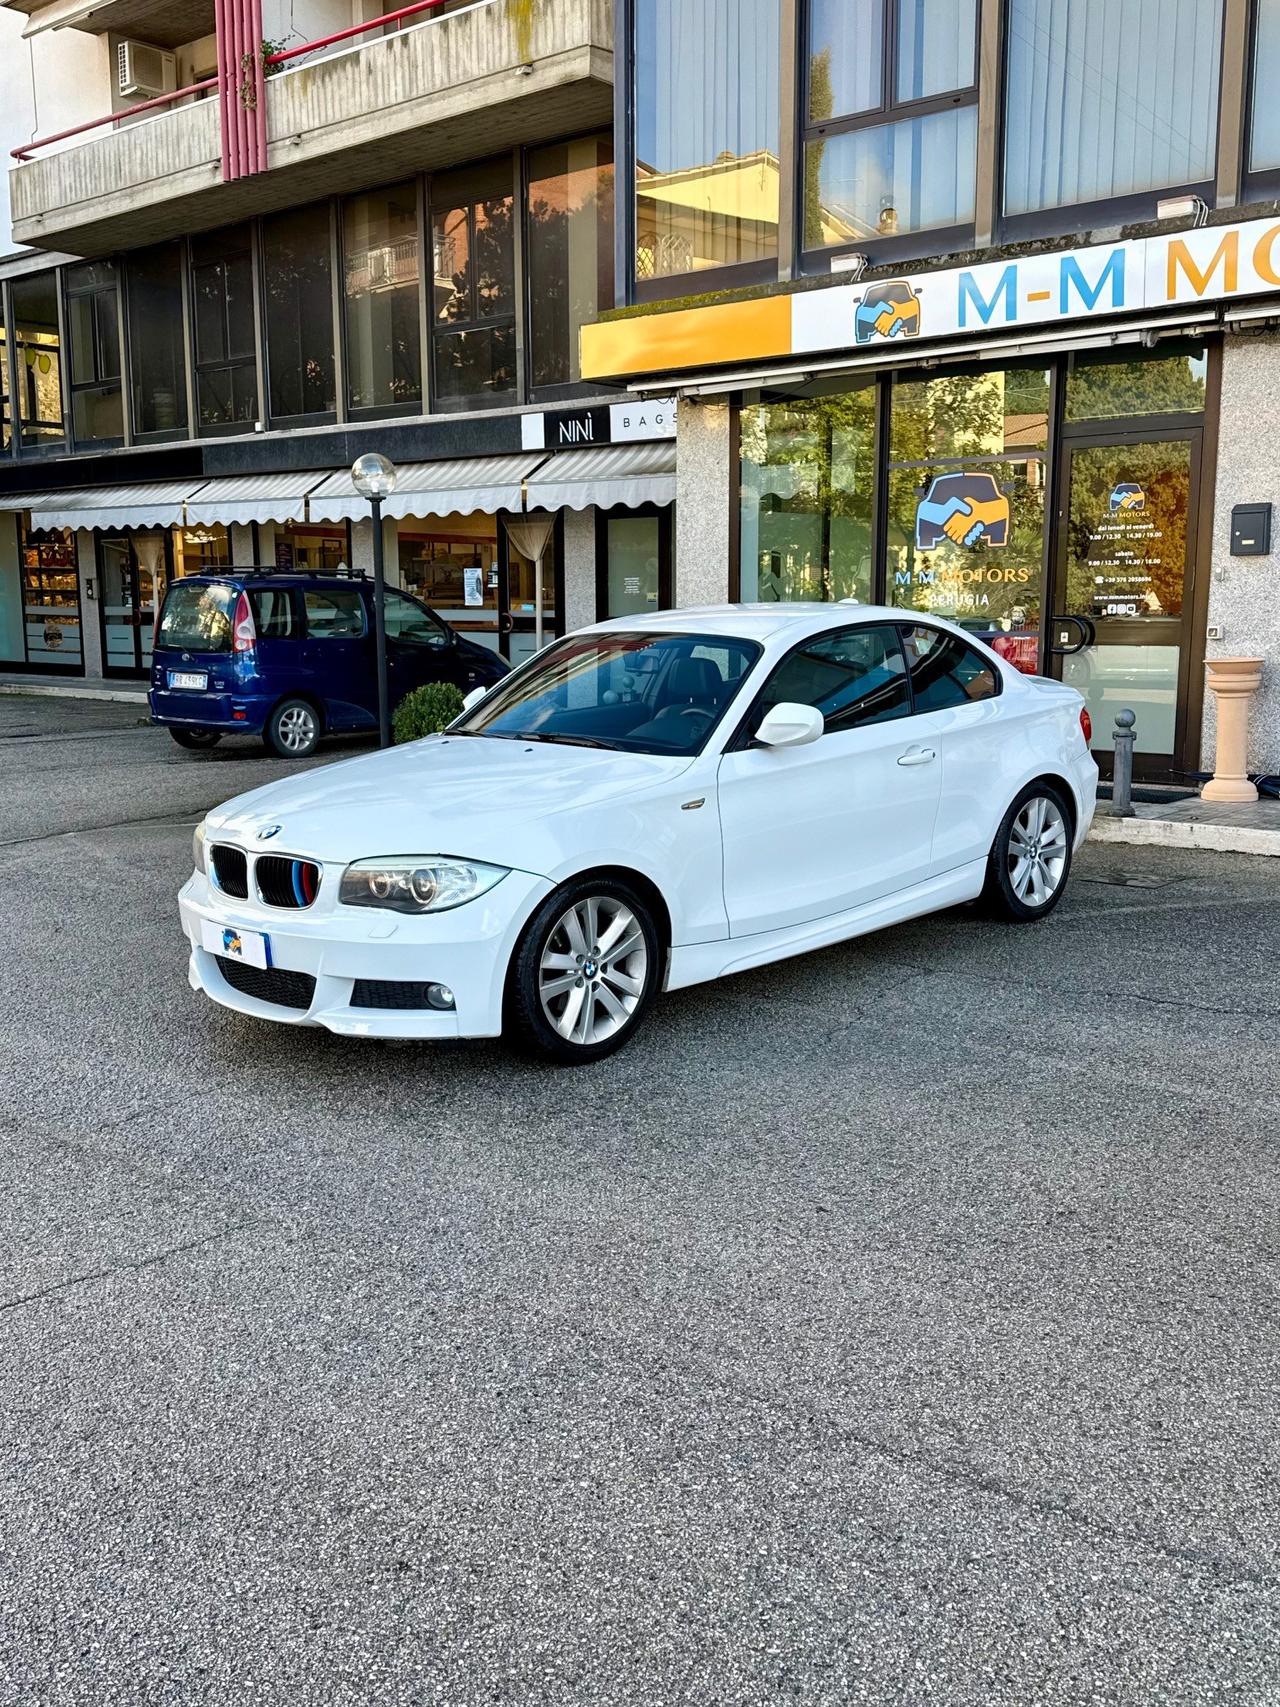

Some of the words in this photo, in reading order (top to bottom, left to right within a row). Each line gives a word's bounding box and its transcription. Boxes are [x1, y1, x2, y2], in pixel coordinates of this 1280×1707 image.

[958, 248, 1126, 328] M-M
[559, 411, 594, 443] NINÌ
[895, 570, 936, 585] M-M
[941, 567, 1029, 584] MOTORS
[930, 593, 990, 606] PERUGIA
